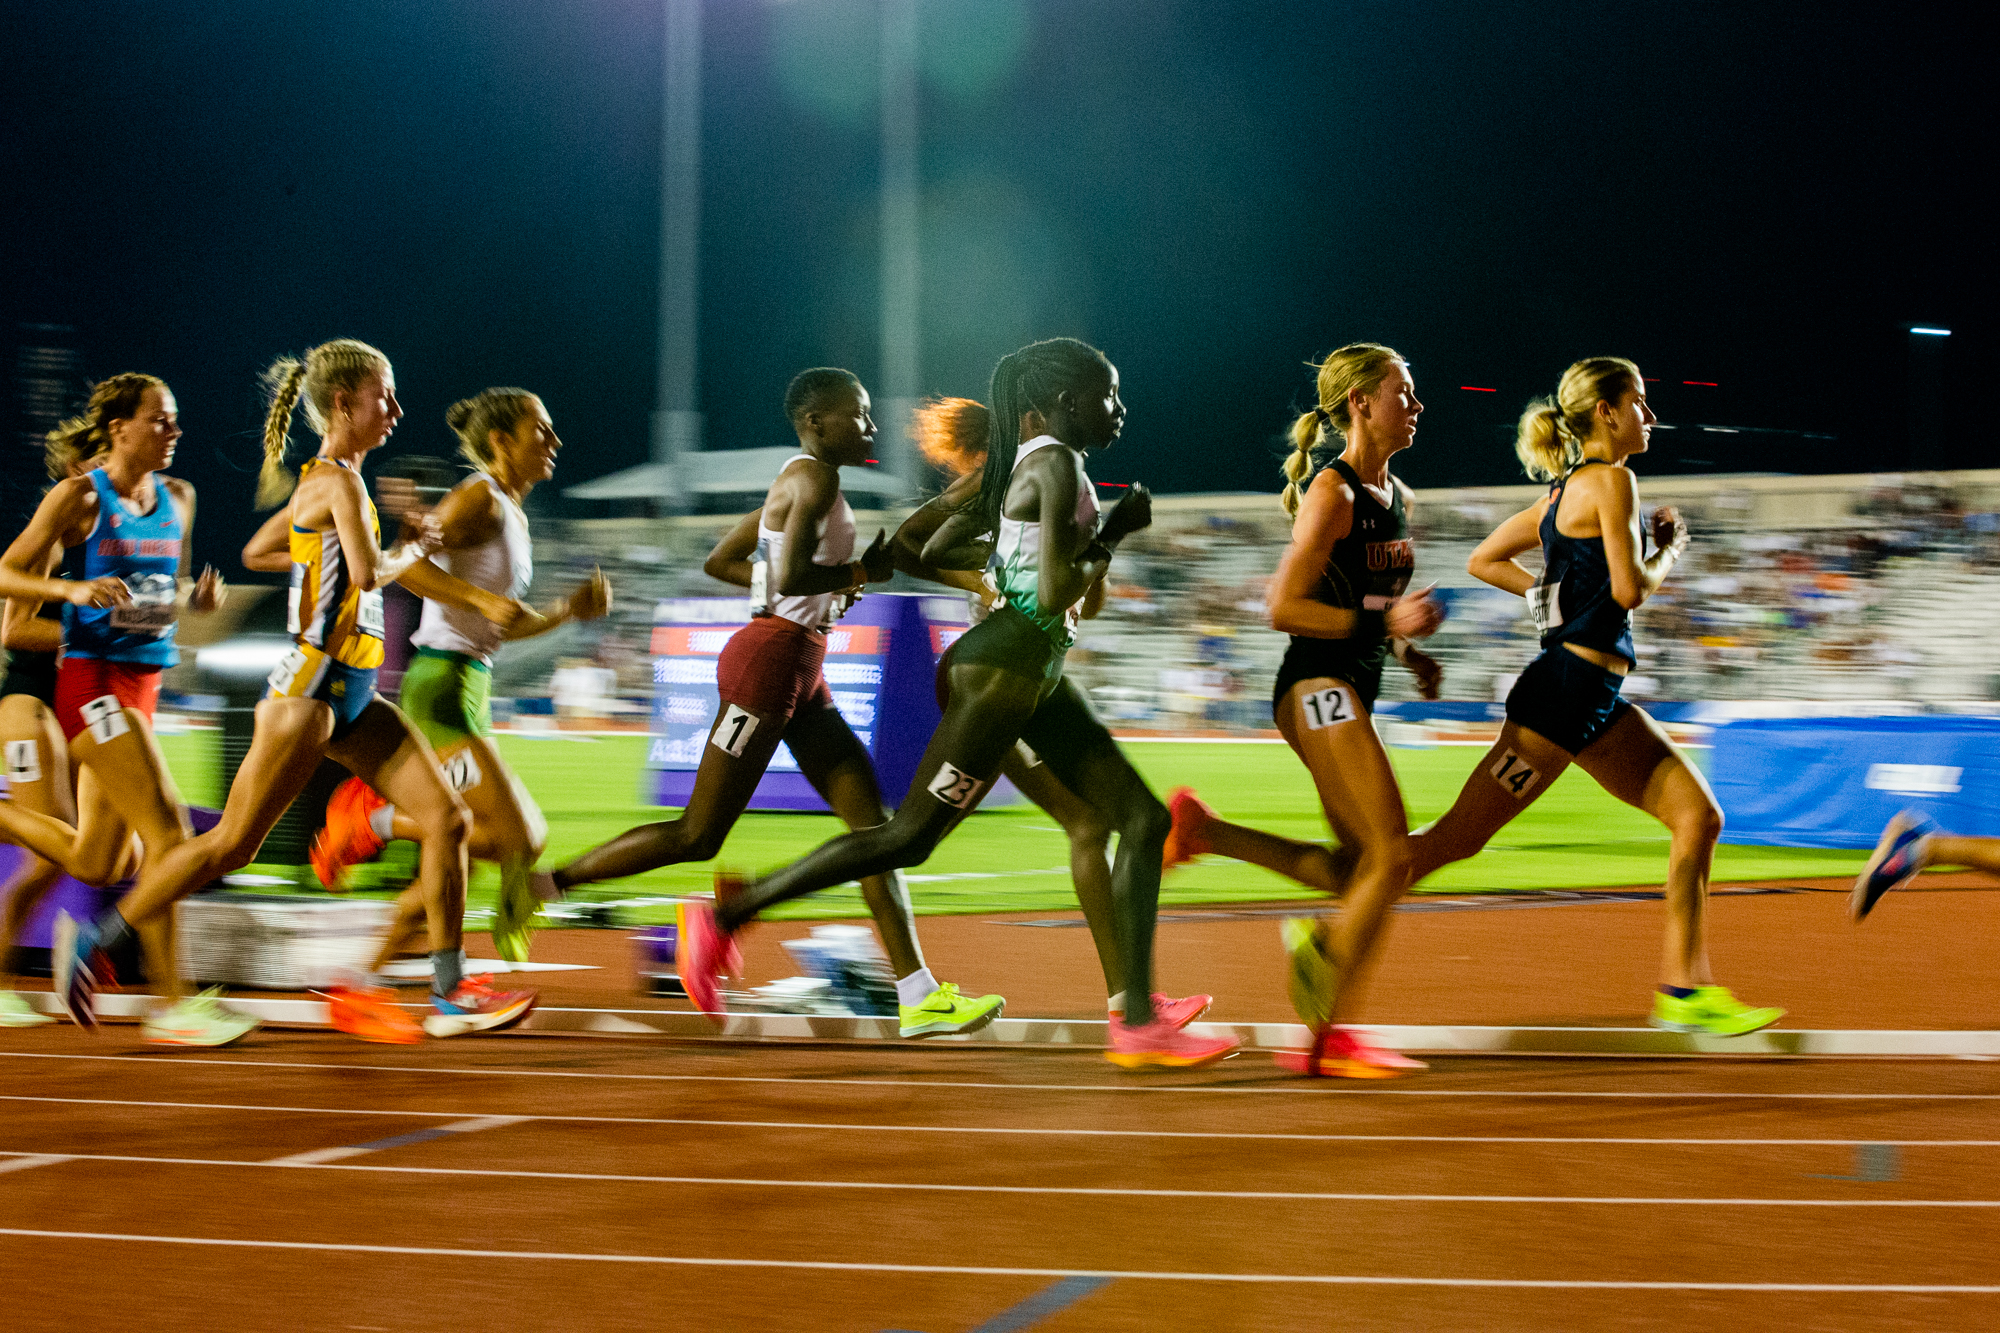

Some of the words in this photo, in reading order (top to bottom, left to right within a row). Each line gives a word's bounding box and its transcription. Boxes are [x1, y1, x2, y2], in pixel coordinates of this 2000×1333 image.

[91, 700, 112, 737] 7
[1306, 690, 1347, 725] 12
[725, 714, 749, 752] 1
[936, 769, 974, 805] 23
[1495, 754, 1534, 793] 14
